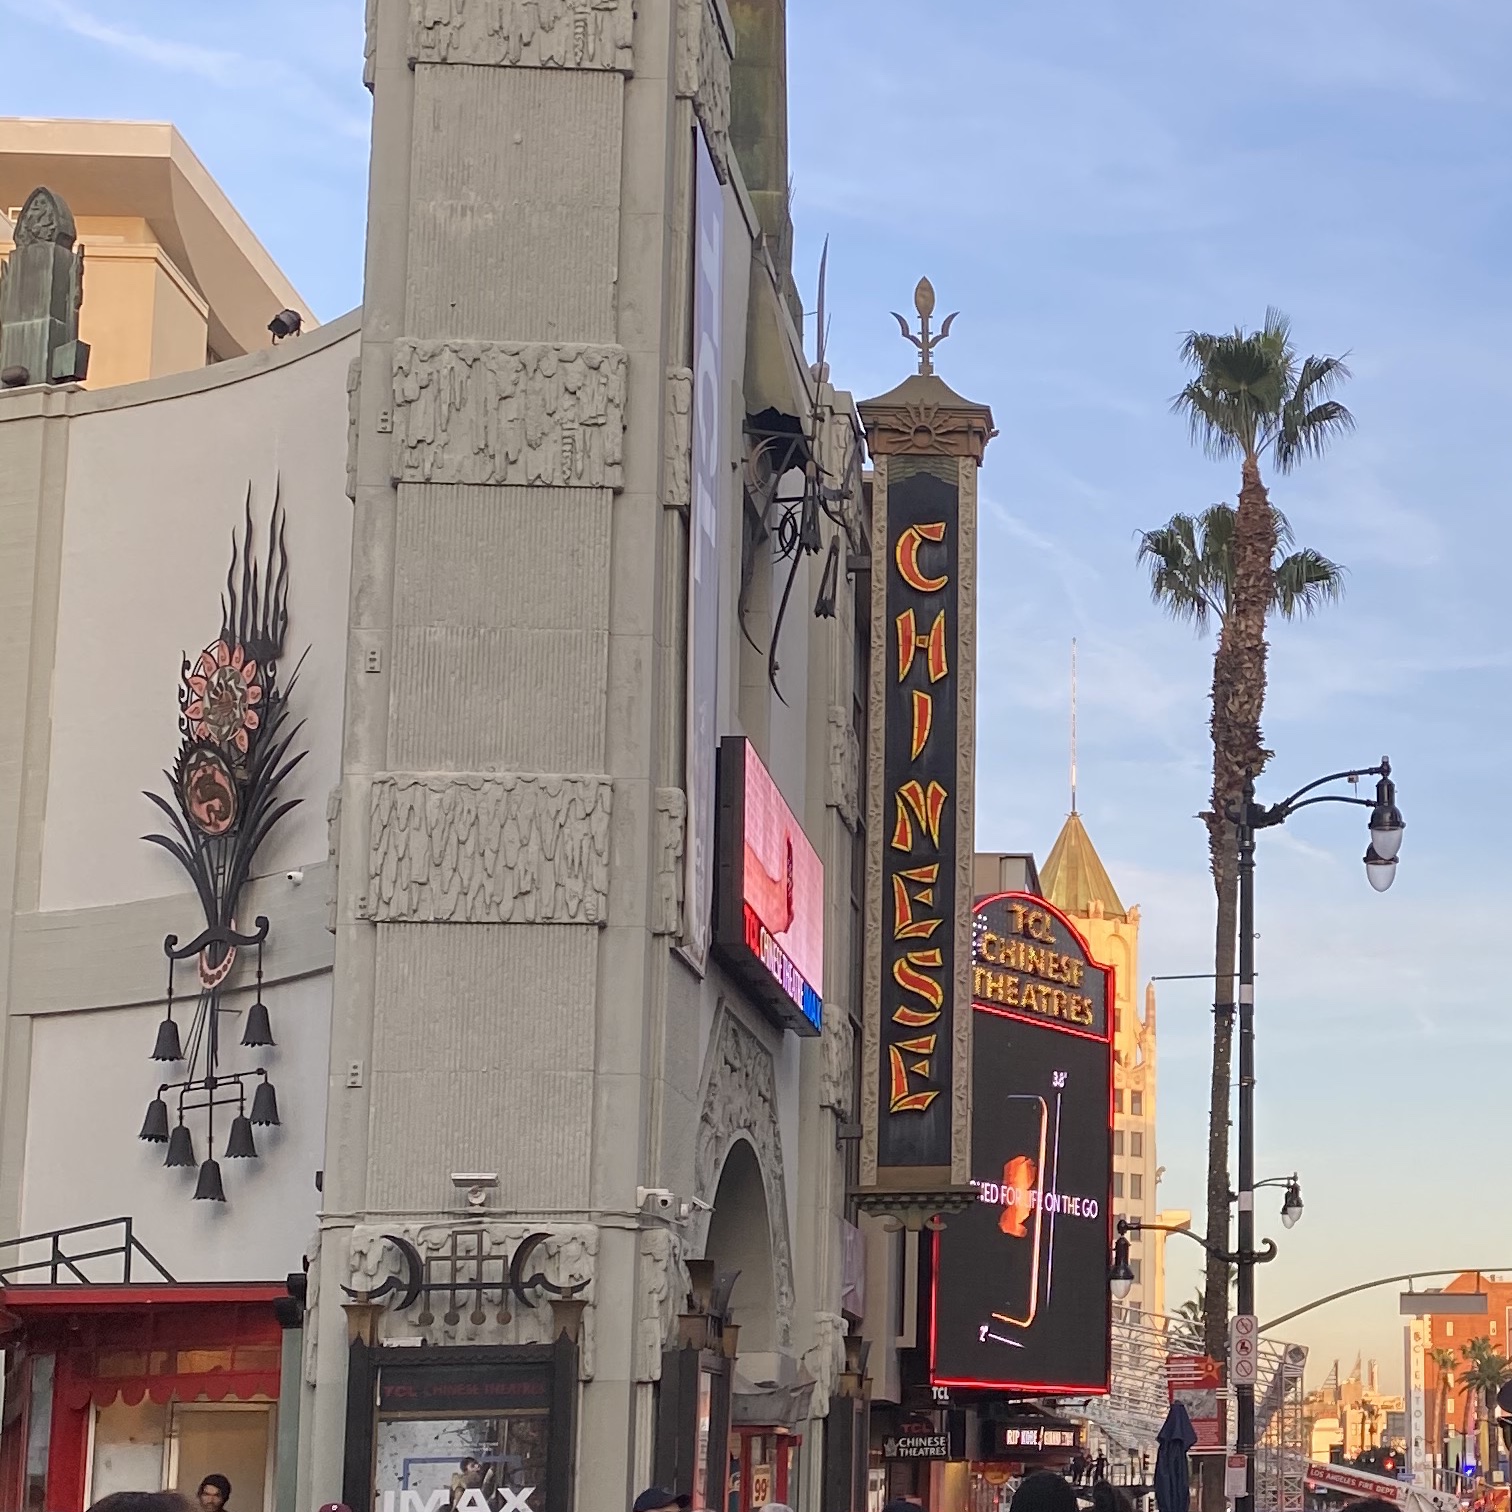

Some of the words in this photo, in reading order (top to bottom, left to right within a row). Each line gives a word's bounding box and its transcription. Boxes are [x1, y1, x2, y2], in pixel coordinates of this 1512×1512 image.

[888, 521, 950, 1114] CHINESE
[1005, 902, 1057, 944] TCL
[978, 931, 1085, 988] CHINESE
[1044, 1192, 1061, 1213] ON
[1061, 1195, 1081, 1216] THE
[1081, 1198, 1099, 1219] GO
[932, 1386, 950, 1400] TCL
[899, 1436, 947, 1447] CHINESE
[899, 1447, 947, 1458] THEATRES
[1310, 1468, 1325, 1479] LOS
[1325, 1472, 1357, 1487] ANGELES
[1358, 1479, 1374, 1490] FIRE
